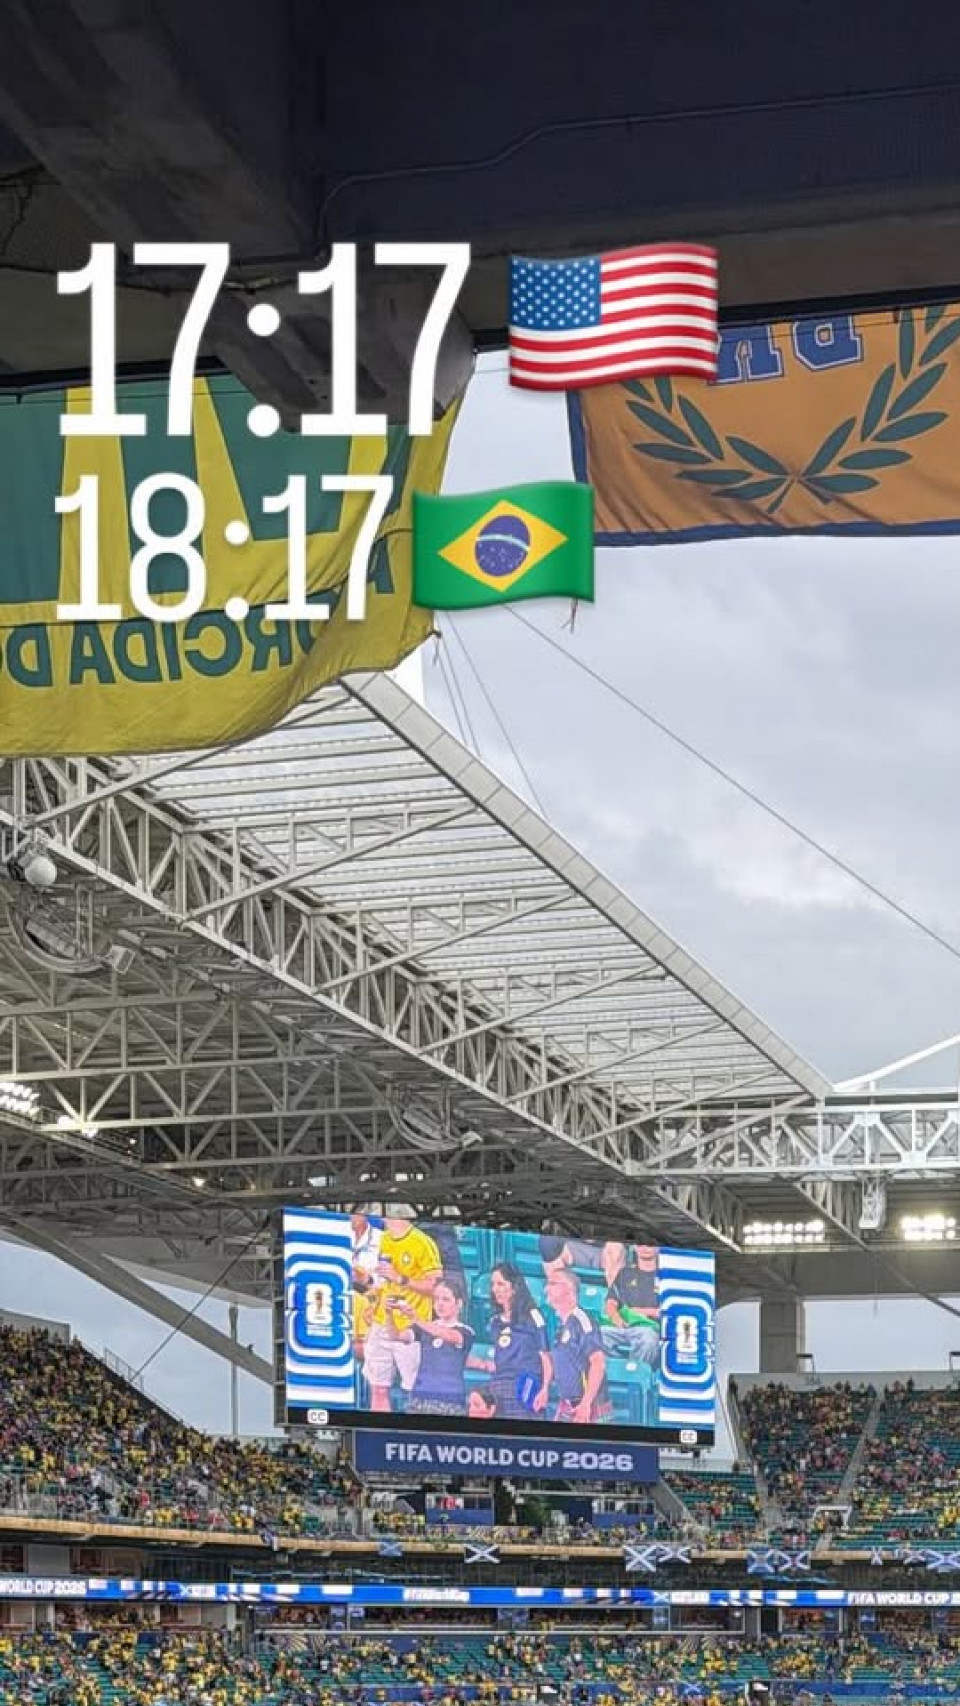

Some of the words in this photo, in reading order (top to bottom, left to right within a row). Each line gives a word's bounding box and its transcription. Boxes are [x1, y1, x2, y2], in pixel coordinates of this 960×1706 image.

[385, 1443, 433, 1463] FIFA
[435, 1444, 515, 1467] WORLD
[517, 1448, 560, 1469] CUP
[563, 1452, 634, 1472] 2026
[876, 1592, 922, 1605] WORLD
[924, 1592, 951, 1605] CUP
